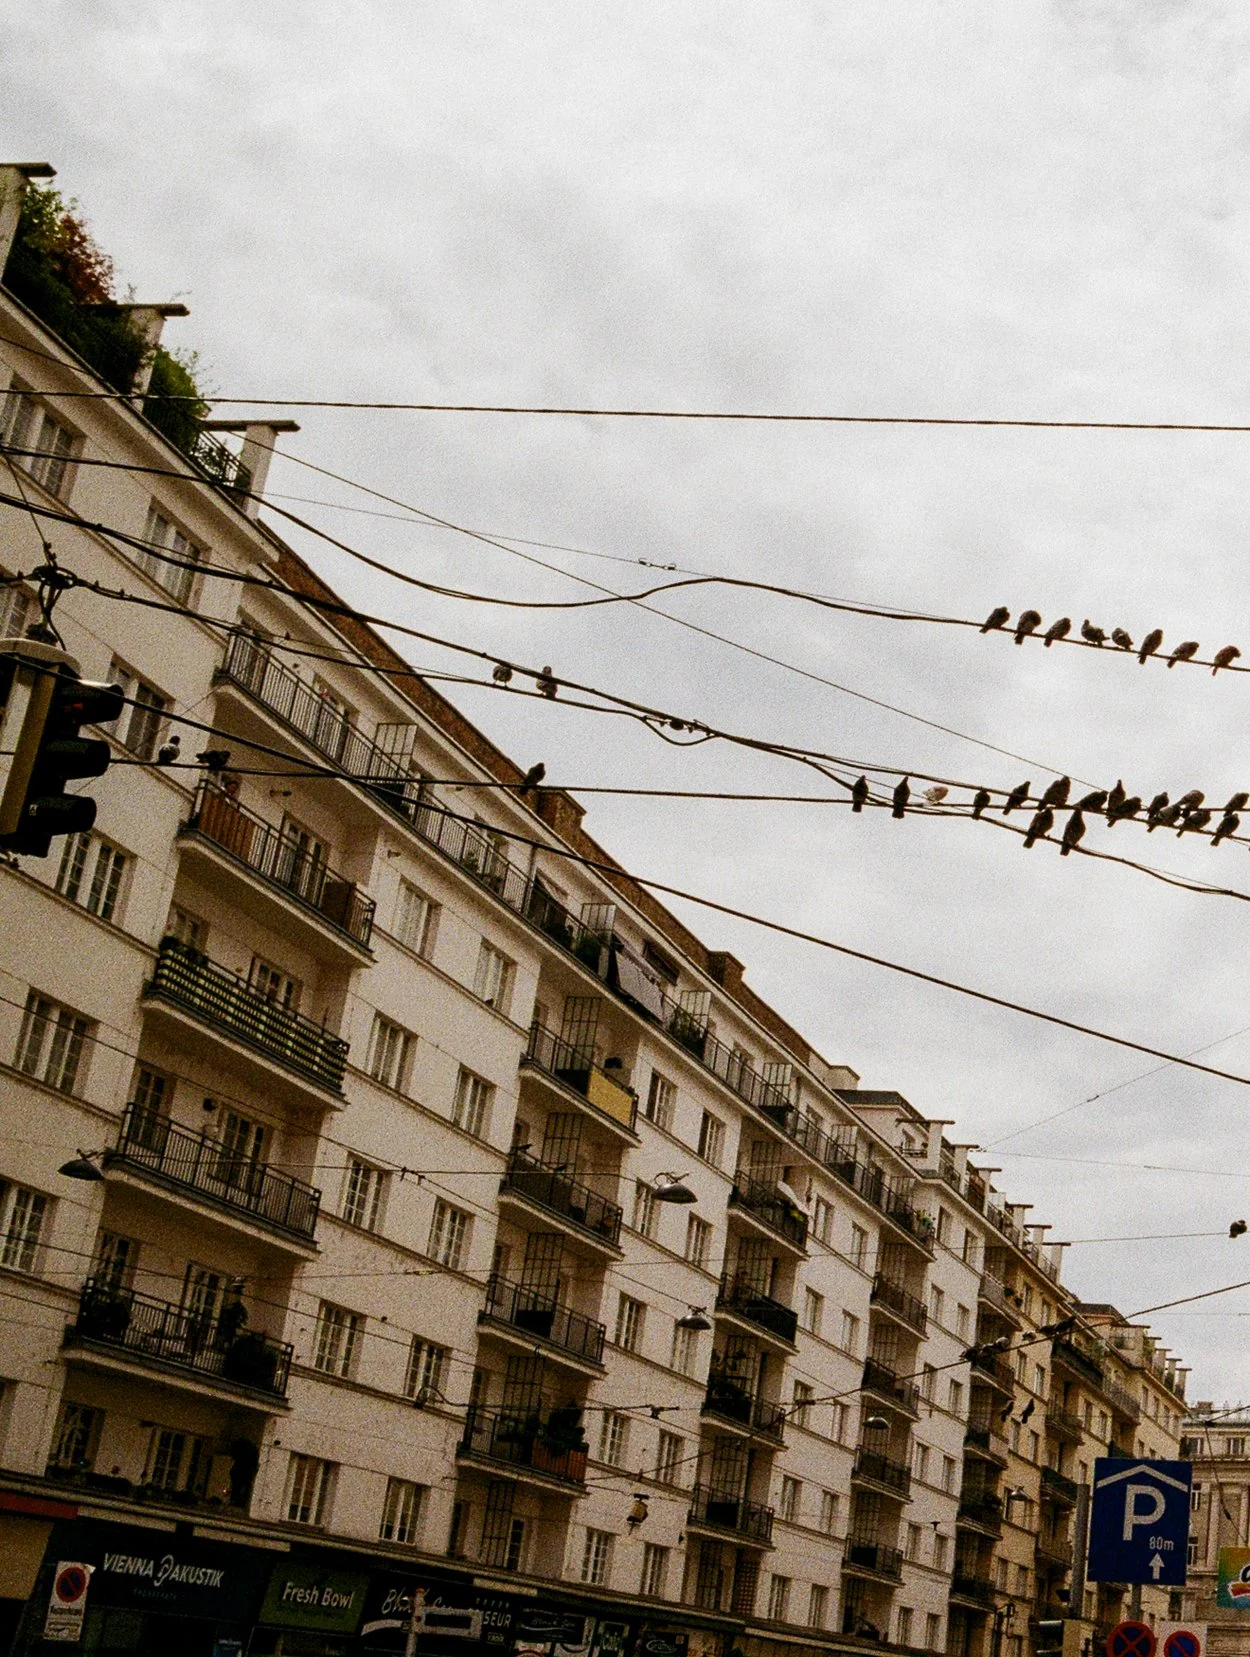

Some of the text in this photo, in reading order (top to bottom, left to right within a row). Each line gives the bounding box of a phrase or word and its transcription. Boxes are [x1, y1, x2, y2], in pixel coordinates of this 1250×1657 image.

[1122, 1484, 1166, 1541] P
[1149, 1536, 1174, 1551] 80m
[102, 1552, 225, 1588] VIENNA AKUSTIK
[282, 1581, 355, 1609] Fresh Bowl
